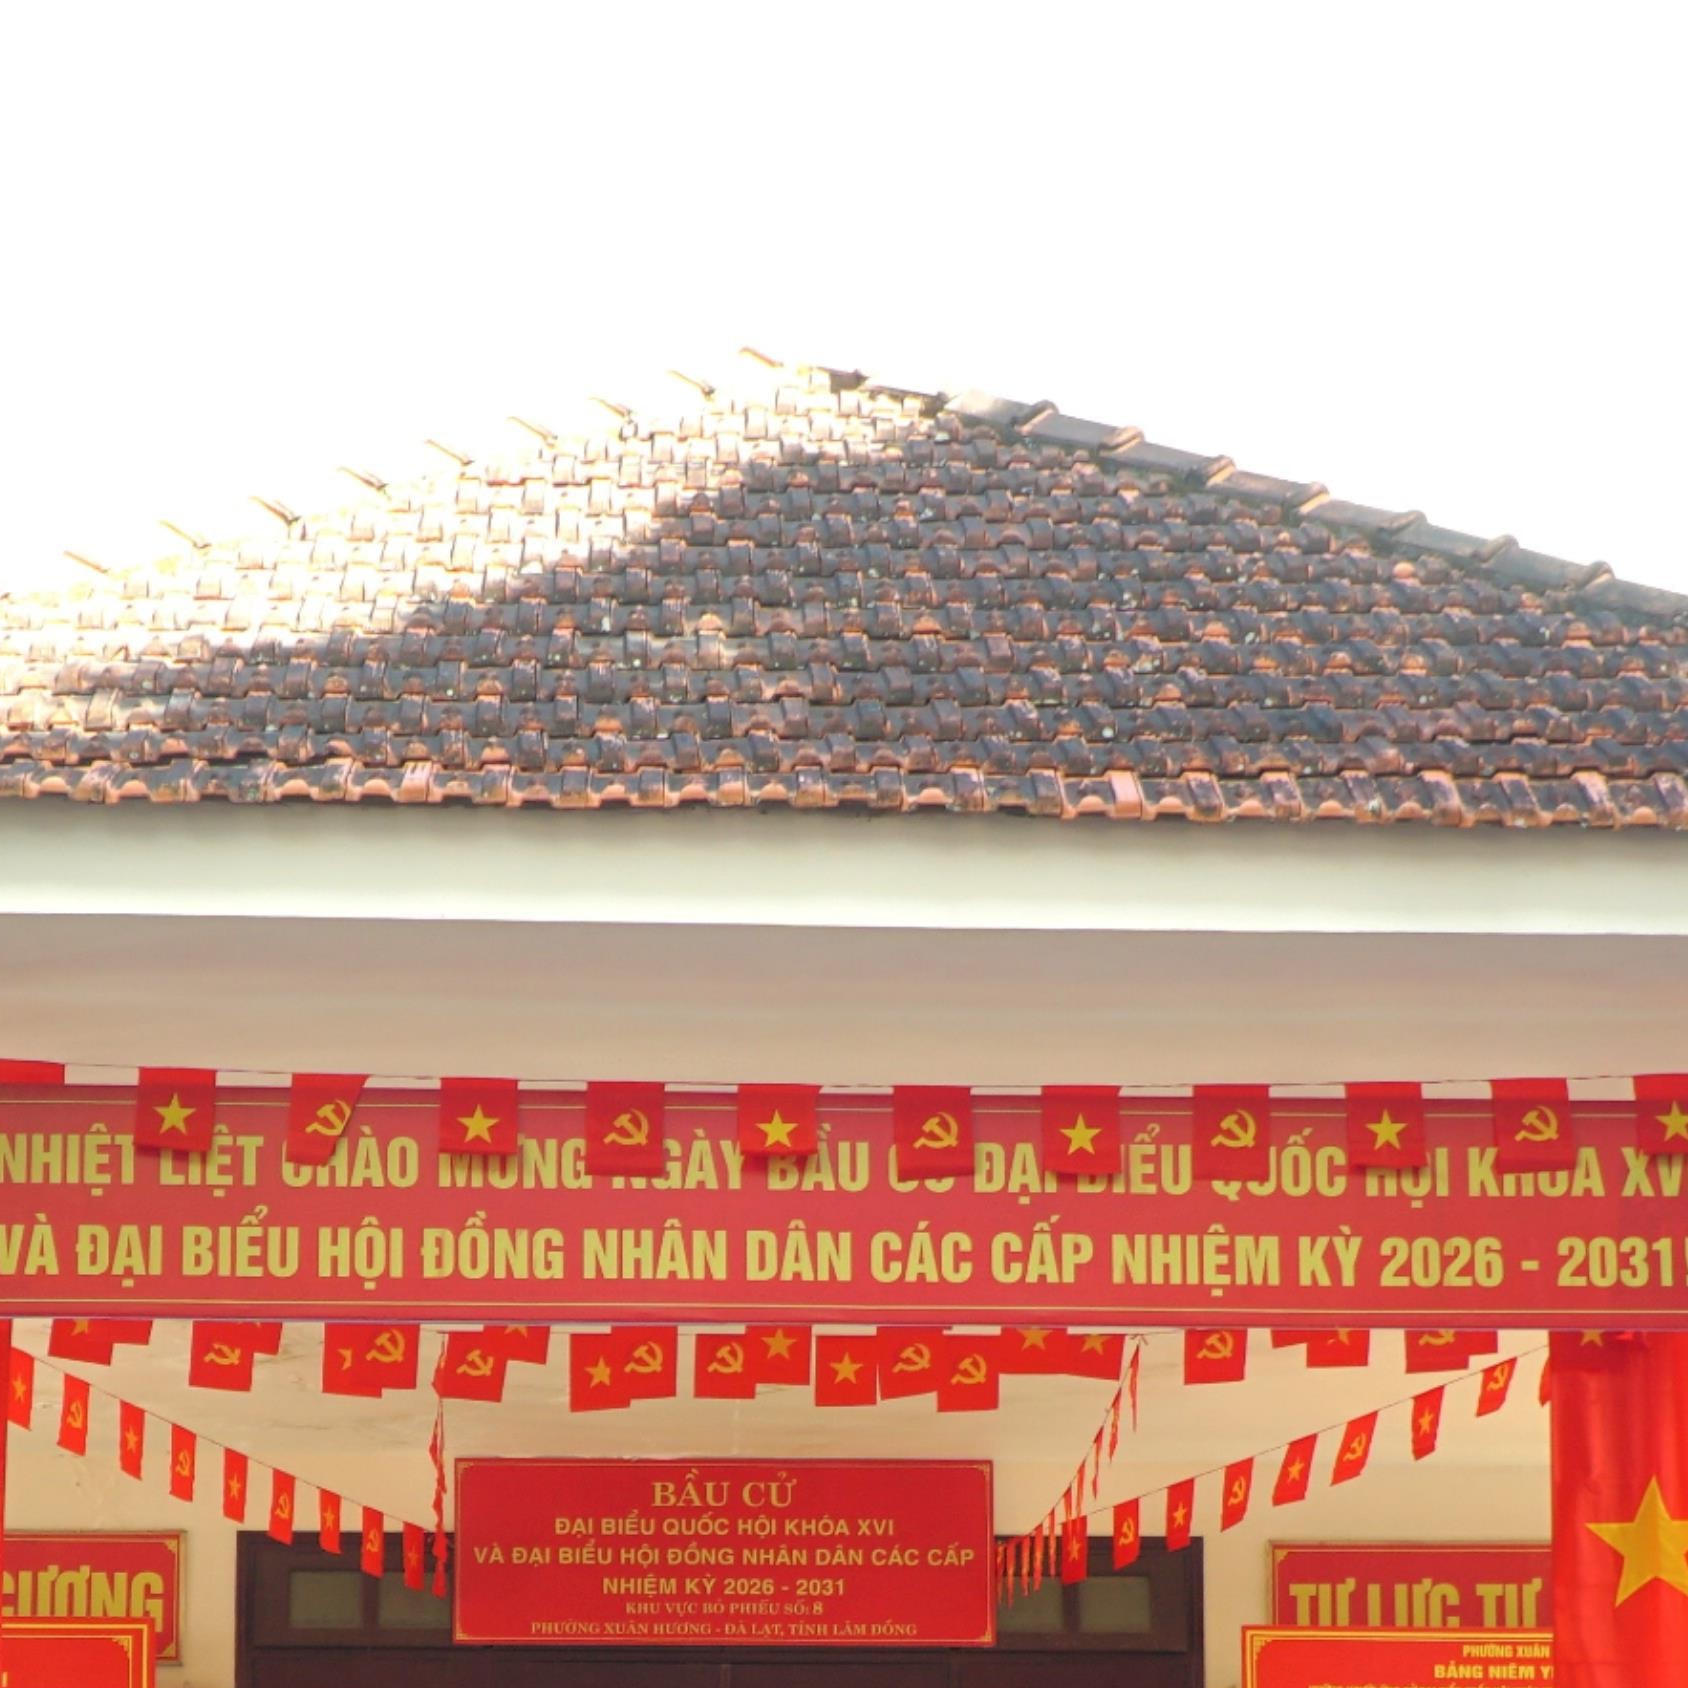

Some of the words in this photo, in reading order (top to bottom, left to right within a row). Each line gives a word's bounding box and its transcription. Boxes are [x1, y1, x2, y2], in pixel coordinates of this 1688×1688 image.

[614, 1126, 744, 1189] GÀY
[75, 1224, 163, 1287] ĐẠI
[182, 1205, 299, 1278] BIỂU
[317, 1216, 404, 1290] HỘI
[421, 1210, 564, 1280] ĐỒNG
[582, 1217, 728, 1281] NHÂN
[746, 1219, 851, 1281] DÂN
[870, 1221, 973, 1283] CÁC
[990, 1214, 1094, 1284] CẤP
[1112, 1224, 1280, 1296] NHIỆM
[1298, 1225, 1363, 1286] KỲ
[1380, 1236, 1504, 1288] 2026
[1521, 1257, 1540, 1269] -
[651, 1468, 730, 1507] BẦU
[742, 1471, 797, 1508] CỬ
[554, 1517, 593, 1539] ĐẠI
[601, 1509, 656, 1536] BIỂU
[662, 1511, 730, 1537] QUỐC
[737, 1515, 776, 1539] HỘI
[784, 1515, 850, 1536] KHÓA
[857, 1519, 894, 1536] XVI
[473, 1543, 504, 1564] VÀ
[512, 1547, 551, 1567] ĐẠI
[558, 1538, 612, 1565] BIỂU
[620, 1543, 659, 1569] HỘI
[667, 1541, 735, 1566] ĐỒNG
[742, 1545, 808, 1566] NHÂN
[815, 1545, 863, 1566] DÂN
[871, 1545, 919, 1566] CÁC
[927, 1542, 975, 1567] CẤP
[602, 1574, 677, 1598] NHIỆM
[685, 1574, 717, 1594] KỲ
[724, 1578, 775, 1595] 2026
[796, 1579, 846, 1596] 2031
[625, 1602, 659, 1614] KHU
[665, 1601, 698, 1617] VỰC
[702, 1599, 725, 1614] BỎ
[729, 1600, 780, 1614] PHIẾU
[813, 1601, 823, 1614] 8
[531, 1619, 600, 1635] PHƯỜNG
[604, 1620, 649, 1635] XUÂN
[653, 1621, 711, 1635] HƯƠNG
[724, 1621, 747, 1635] ĐÀ
[833, 1621, 867, 1636] LÂM
[871, 1619, 917, 1636] ĐỒNG
[1434, 1661, 1483, 1679] BẢNG
[1488, 1662, 1535, 1679] NIÊM
